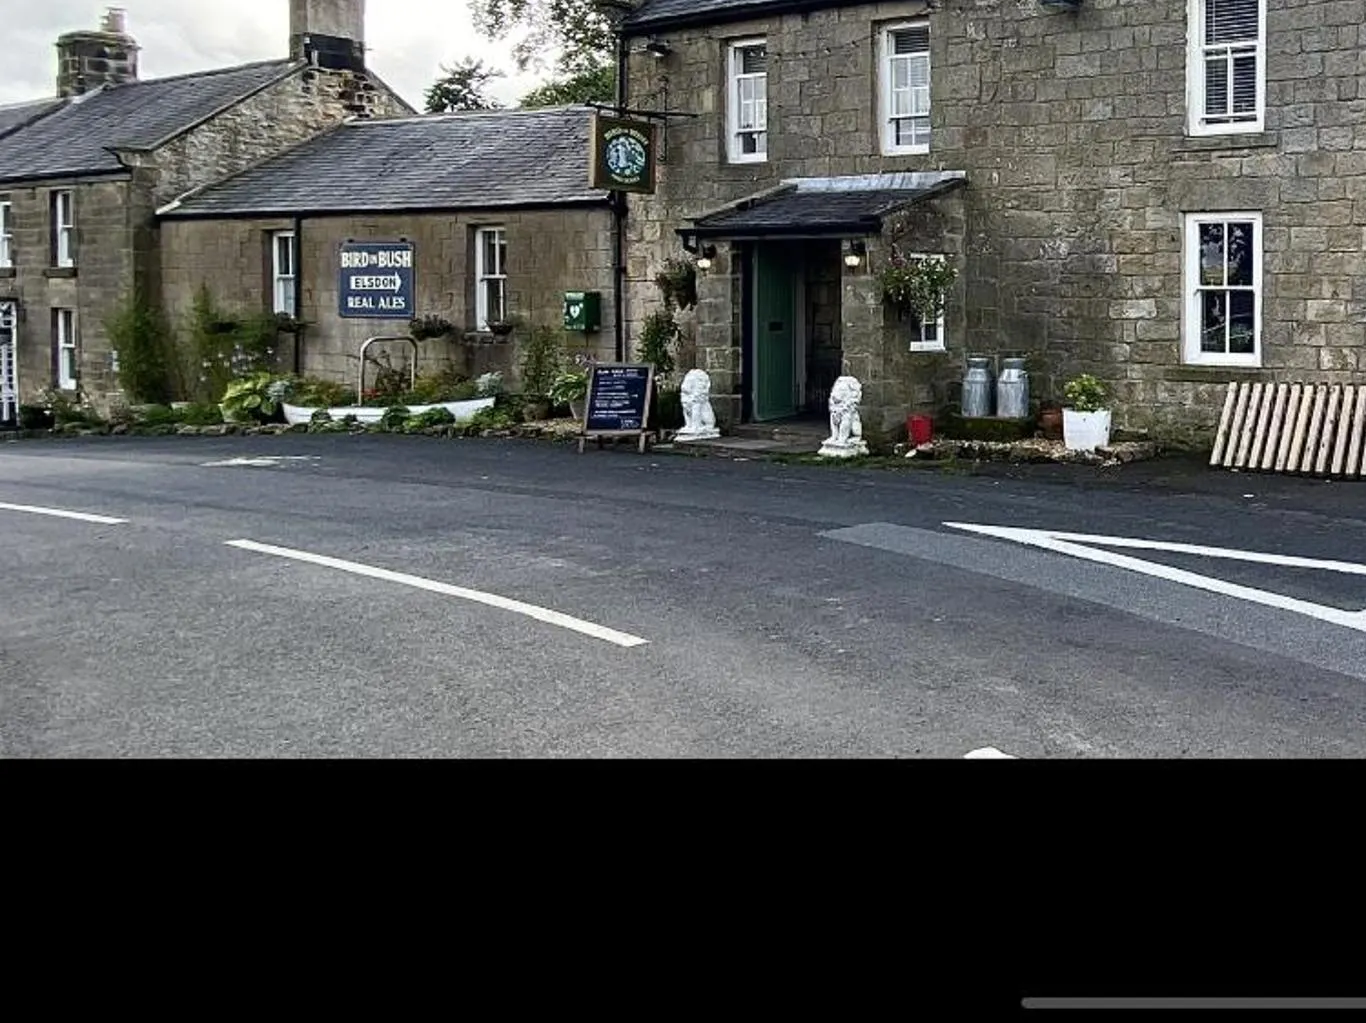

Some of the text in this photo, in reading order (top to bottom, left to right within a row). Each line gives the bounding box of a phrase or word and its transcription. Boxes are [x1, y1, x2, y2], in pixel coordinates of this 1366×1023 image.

[341, 251, 368, 268] BIRD
[378, 250, 412, 268] BUSH
[354, 277, 396, 288] ELSDON
[347, 296, 405, 309] REAL ALES
